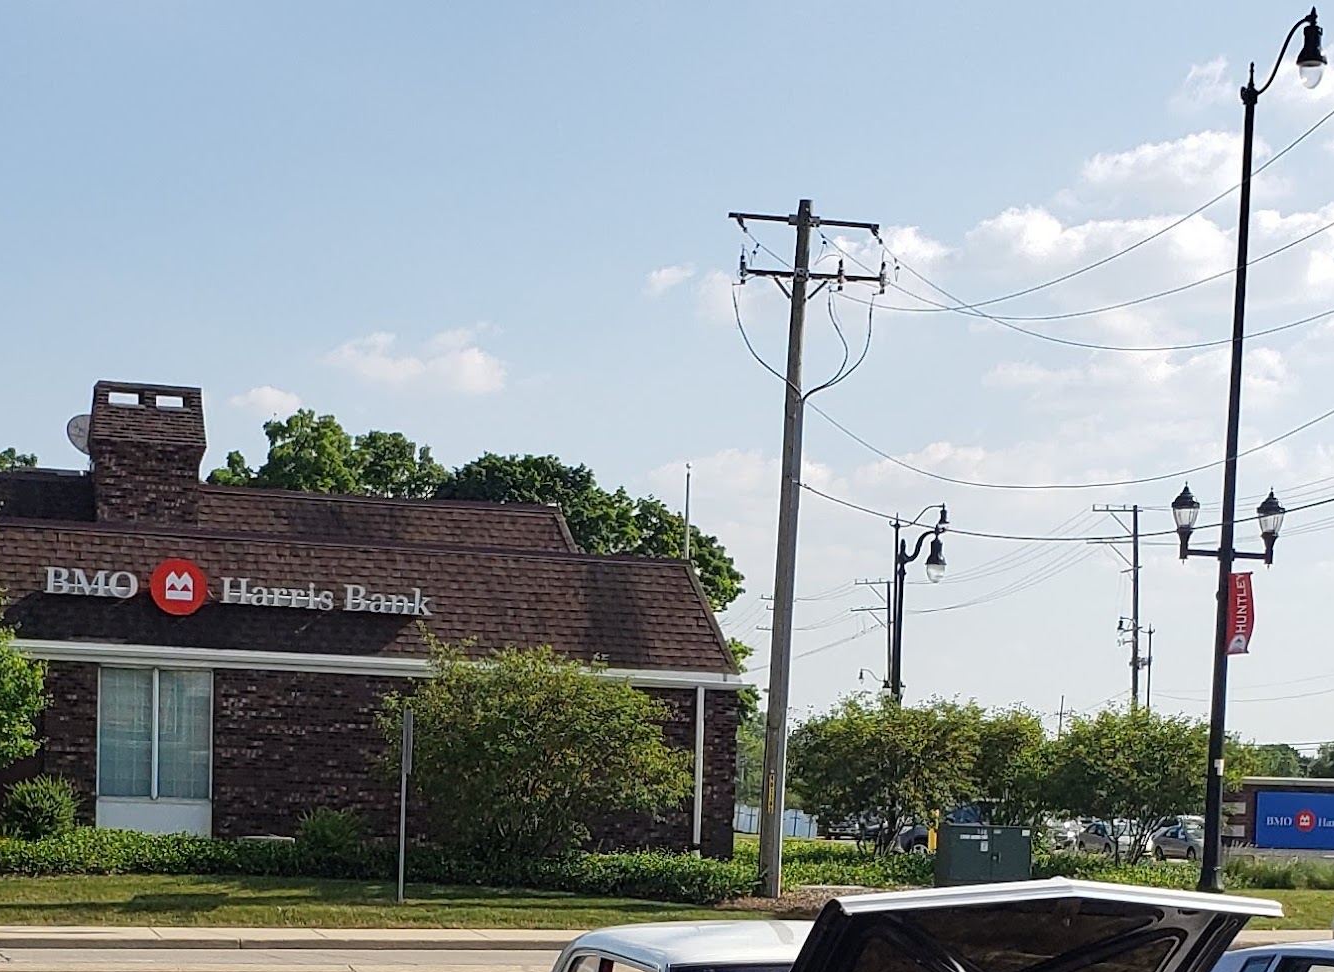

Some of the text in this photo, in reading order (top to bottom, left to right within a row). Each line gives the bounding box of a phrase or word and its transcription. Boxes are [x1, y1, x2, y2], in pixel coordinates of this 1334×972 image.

[44, 566, 432, 616] BMO Harris Bank
[1235, 574, 1247, 633] HUNTLEY
[1266, 816, 1293, 826] BMO
